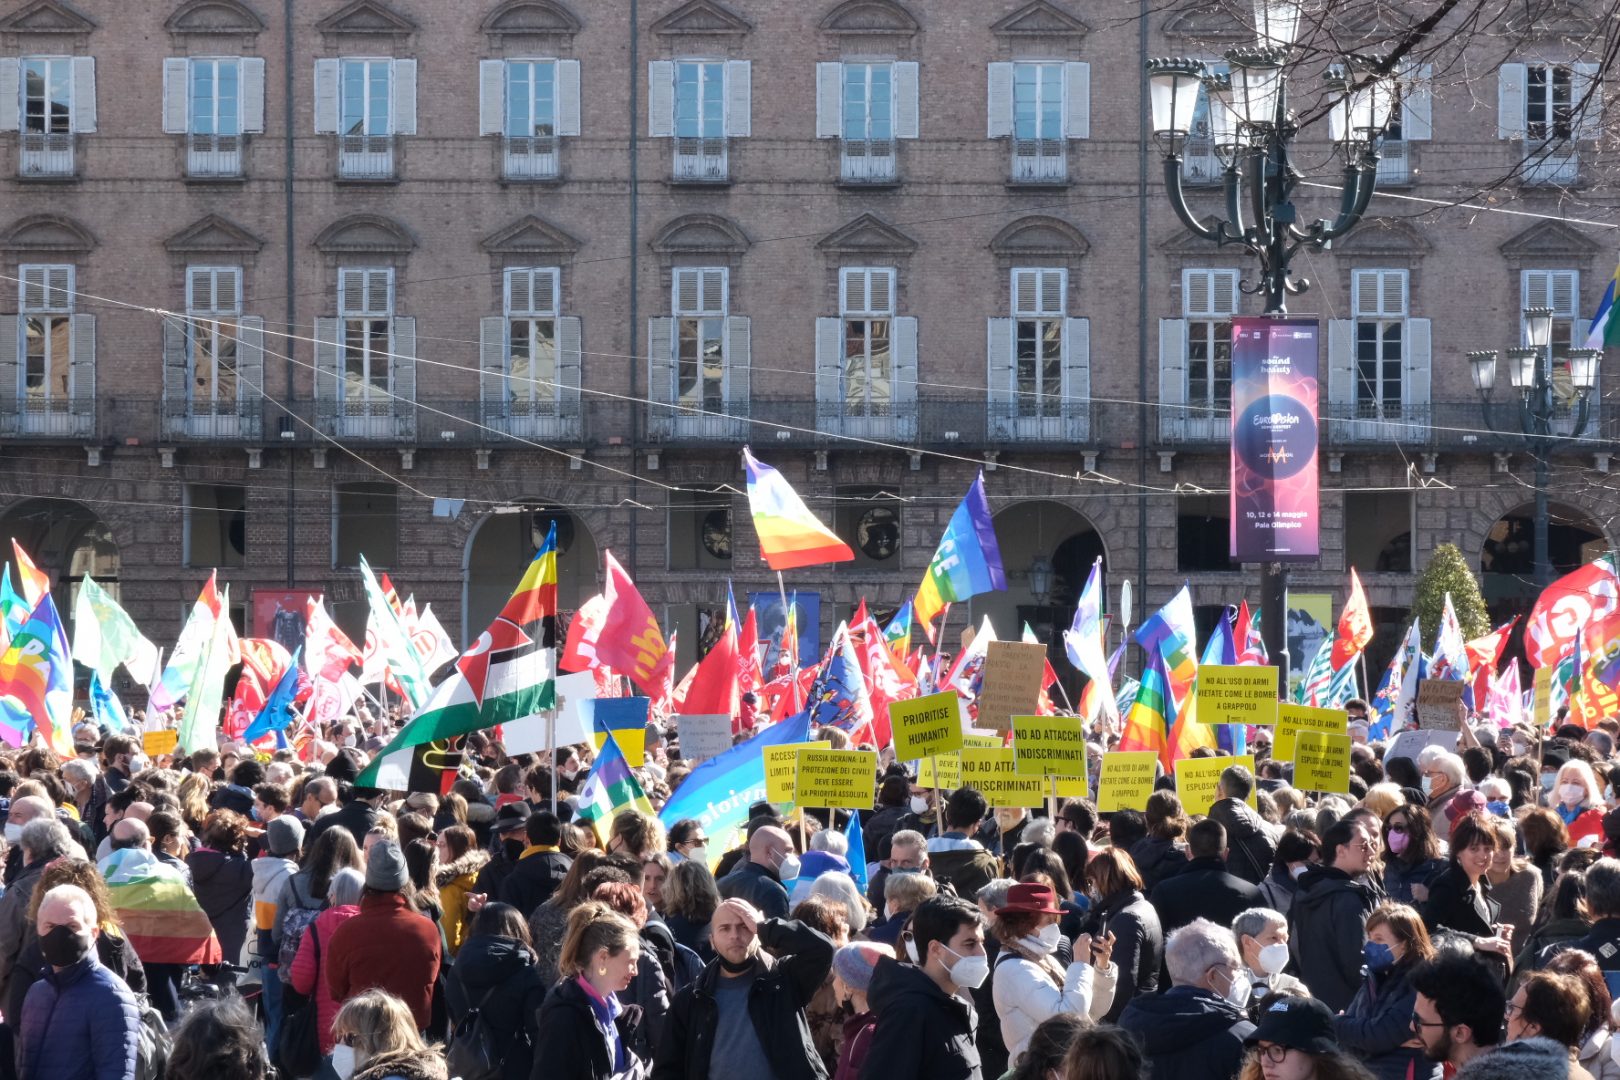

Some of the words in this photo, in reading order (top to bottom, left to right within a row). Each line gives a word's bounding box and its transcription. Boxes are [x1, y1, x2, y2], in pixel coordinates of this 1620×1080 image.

[1216, 678, 1242, 686] ALL'USO
[1244, 678, 1251, 686] DI
[1252, 678, 1269, 686] ARMI
[1198, 690, 1223, 698] VIETATE
[1224, 690, 1242, 698] COME
[903, 708, 950, 726] PRIORITISE
[1325, 721, 1340, 729] ARMI
[908, 727, 950, 745] HUMANITY
[1015, 729, 1027, 740] NO
[1030, 730, 1041, 740] AD
[1044, 730, 1081, 742] ATTACCHI
[807, 754, 828, 762] RUSSIA
[1017, 748, 1082, 760] INDISCRIMINATI
[938, 760, 954, 768] DEVE
[962, 762, 975, 772] NO
[978, 762, 991, 772] AD
[1107, 764, 1114, 772] NO
[1132, 764, 1138, 772] DI
[1138, 764, 1150, 772] ARMI
[770, 768, 790, 777] LIMITI
[802, 766, 838, 774] PROTEZIONE
[852, 767, 870, 776] CIVILI
[1184, 771, 1194, 779] NO
[1195, 770, 1220, 778] ALL'USO
[814, 778, 829, 786] DEVE
[832, 778, 854, 786] ESSERE
[838, 790, 868, 799] ASSOLUTA
[1116, 790, 1140, 798] GRAPPOLO
[1202, 794, 1215, 802] POP
